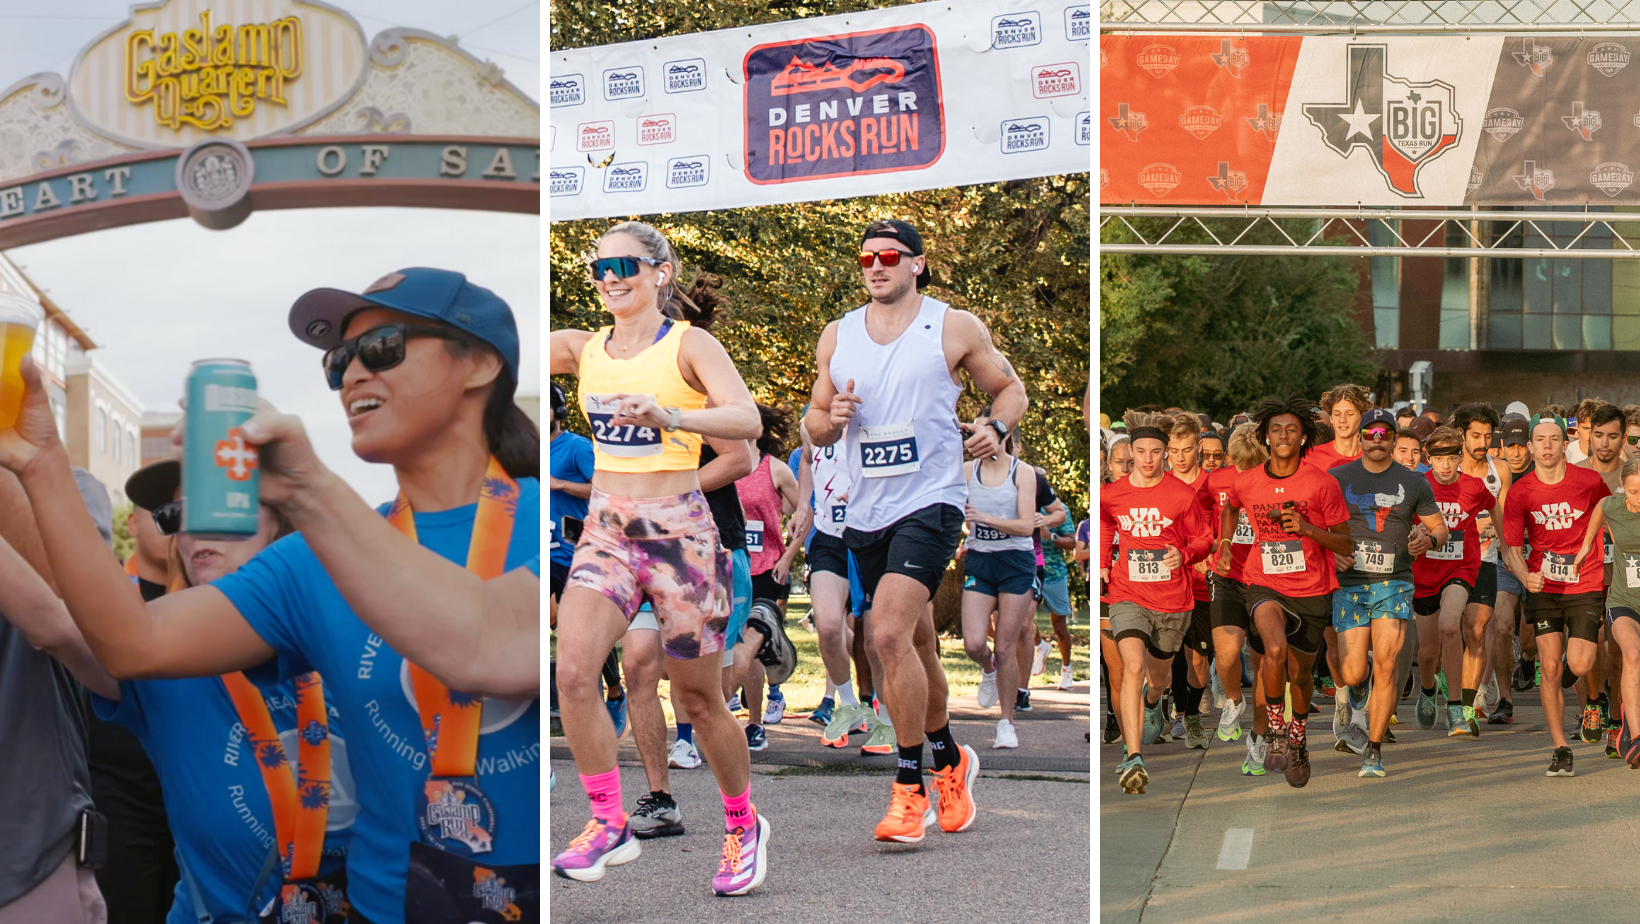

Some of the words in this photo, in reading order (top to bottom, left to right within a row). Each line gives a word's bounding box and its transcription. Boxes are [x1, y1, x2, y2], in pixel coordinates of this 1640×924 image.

[998, 27, 1035, 35] DENVER
[998, 33, 1021, 45] ROCKS
[1022, 32, 1036, 42] RUN
[125, 10, 302, 104] Gaslamp
[1139, 53, 1179, 66] GAMEDAY
[1232, 52, 1245, 64] BIG
[1534, 51, 1548, 62] BIG
[1589, 52, 1630, 64] GAMEDAY
[609, 80, 640, 88] DENVER
[670, 79, 689, 89] ROCKS
[690, 78, 702, 87] RUN
[1038, 77, 1074, 85] DENVER
[609, 86, 628, 96] ROCKS
[628, 85, 640, 94] RUN
[1039, 84, 1061, 94] ROCKS
[1061, 82, 1075, 92] RUN
[154, 62, 288, 131] Quarter
[569, 93, 581, 101] RUN
[769, 91, 918, 127] DENVER
[1129, 116, 1142, 128] BIG
[1181, 115, 1221, 126] GAMEDAY
[1268, 117, 1281, 128] BIG
[1392, 106, 1437, 140] BIG
[1584, 116, 1596, 126] BIG
[642, 126, 671, 134] DENVER
[1007, 132, 1044, 140] DENVER
[642, 132, 659, 142] ROCKS
[660, 131, 671, 140] RUN
[769, 119, 856, 166] ROCKS
[860, 113, 919, 156] RUN
[582, 139, 599, 148] ROCKS
[600, 138, 610, 146] RUN
[1007, 139, 1030, 149] ROCKS
[1030, 137, 1044, 146] RUN
[0, 167, 131, 218] EART
[316, 145, 390, 177] OF
[439, 145, 540, 182] SA
[671, 175, 691, 185] ROCKS
[692, 174, 704, 183] RUN
[1140, 172, 1180, 184] GAMEDAY
[1229, 177, 1242, 187] BIG
[1536, 175, 1548, 186] BIG
[1591, 172, 1632, 184] GAMEDAY
[565, 183, 577, 192] RUN
[608, 180, 628, 189] ROCKS
[628, 180, 642, 188] RUN
[1374, 409, 1383, 419] P
[593, 419, 656, 443] 2274
[865, 443, 913, 465] 2275
[1542, 501, 1573, 531] XC
[1130, 508, 1161, 537] XC
[1236, 525, 1255, 537] 821
[1271, 553, 1294, 566] 820
[1365, 553, 1385, 565] 749
[1138, 562, 1159, 574] 813
[1550, 563, 1569, 576] 814
[364, 699, 427, 770] Running
[224, 722, 247, 767] RIVER
[228, 785, 276, 849] Running
